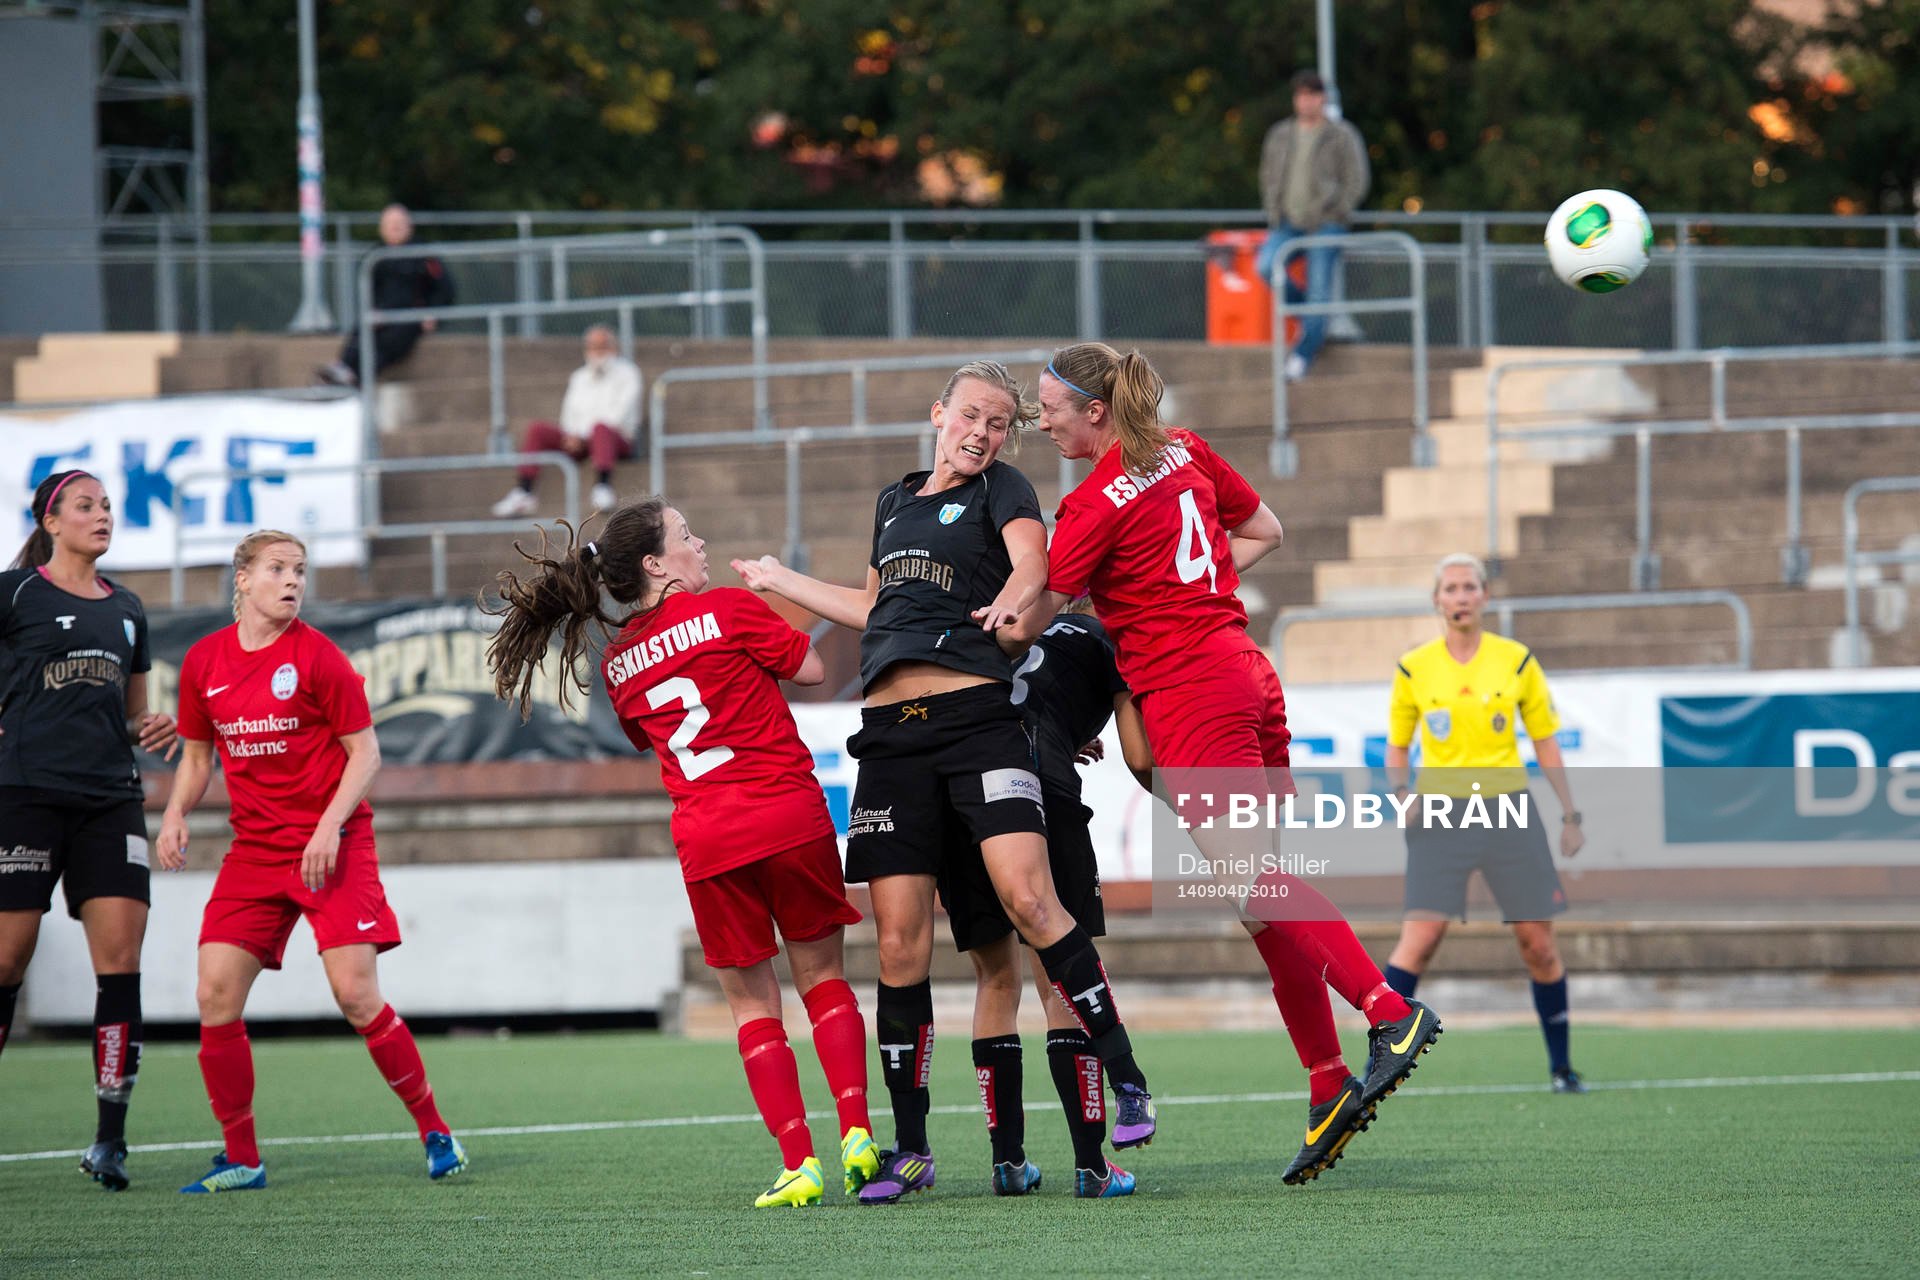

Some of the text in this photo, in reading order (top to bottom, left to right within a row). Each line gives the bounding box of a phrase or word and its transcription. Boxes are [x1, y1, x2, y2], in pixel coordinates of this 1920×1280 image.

[908, 549, 930, 557] CIDER
[1175, 488, 1218, 593] 4
[607, 612, 722, 688] ESKILSTUNA
[226, 739, 288, 757] Rekarne
[645, 676, 735, 782] 2
[878, 822, 895, 832] AB
[99, 1024, 122, 1086] Stavdal
[1079, 1055, 1101, 1120] Stavdal
